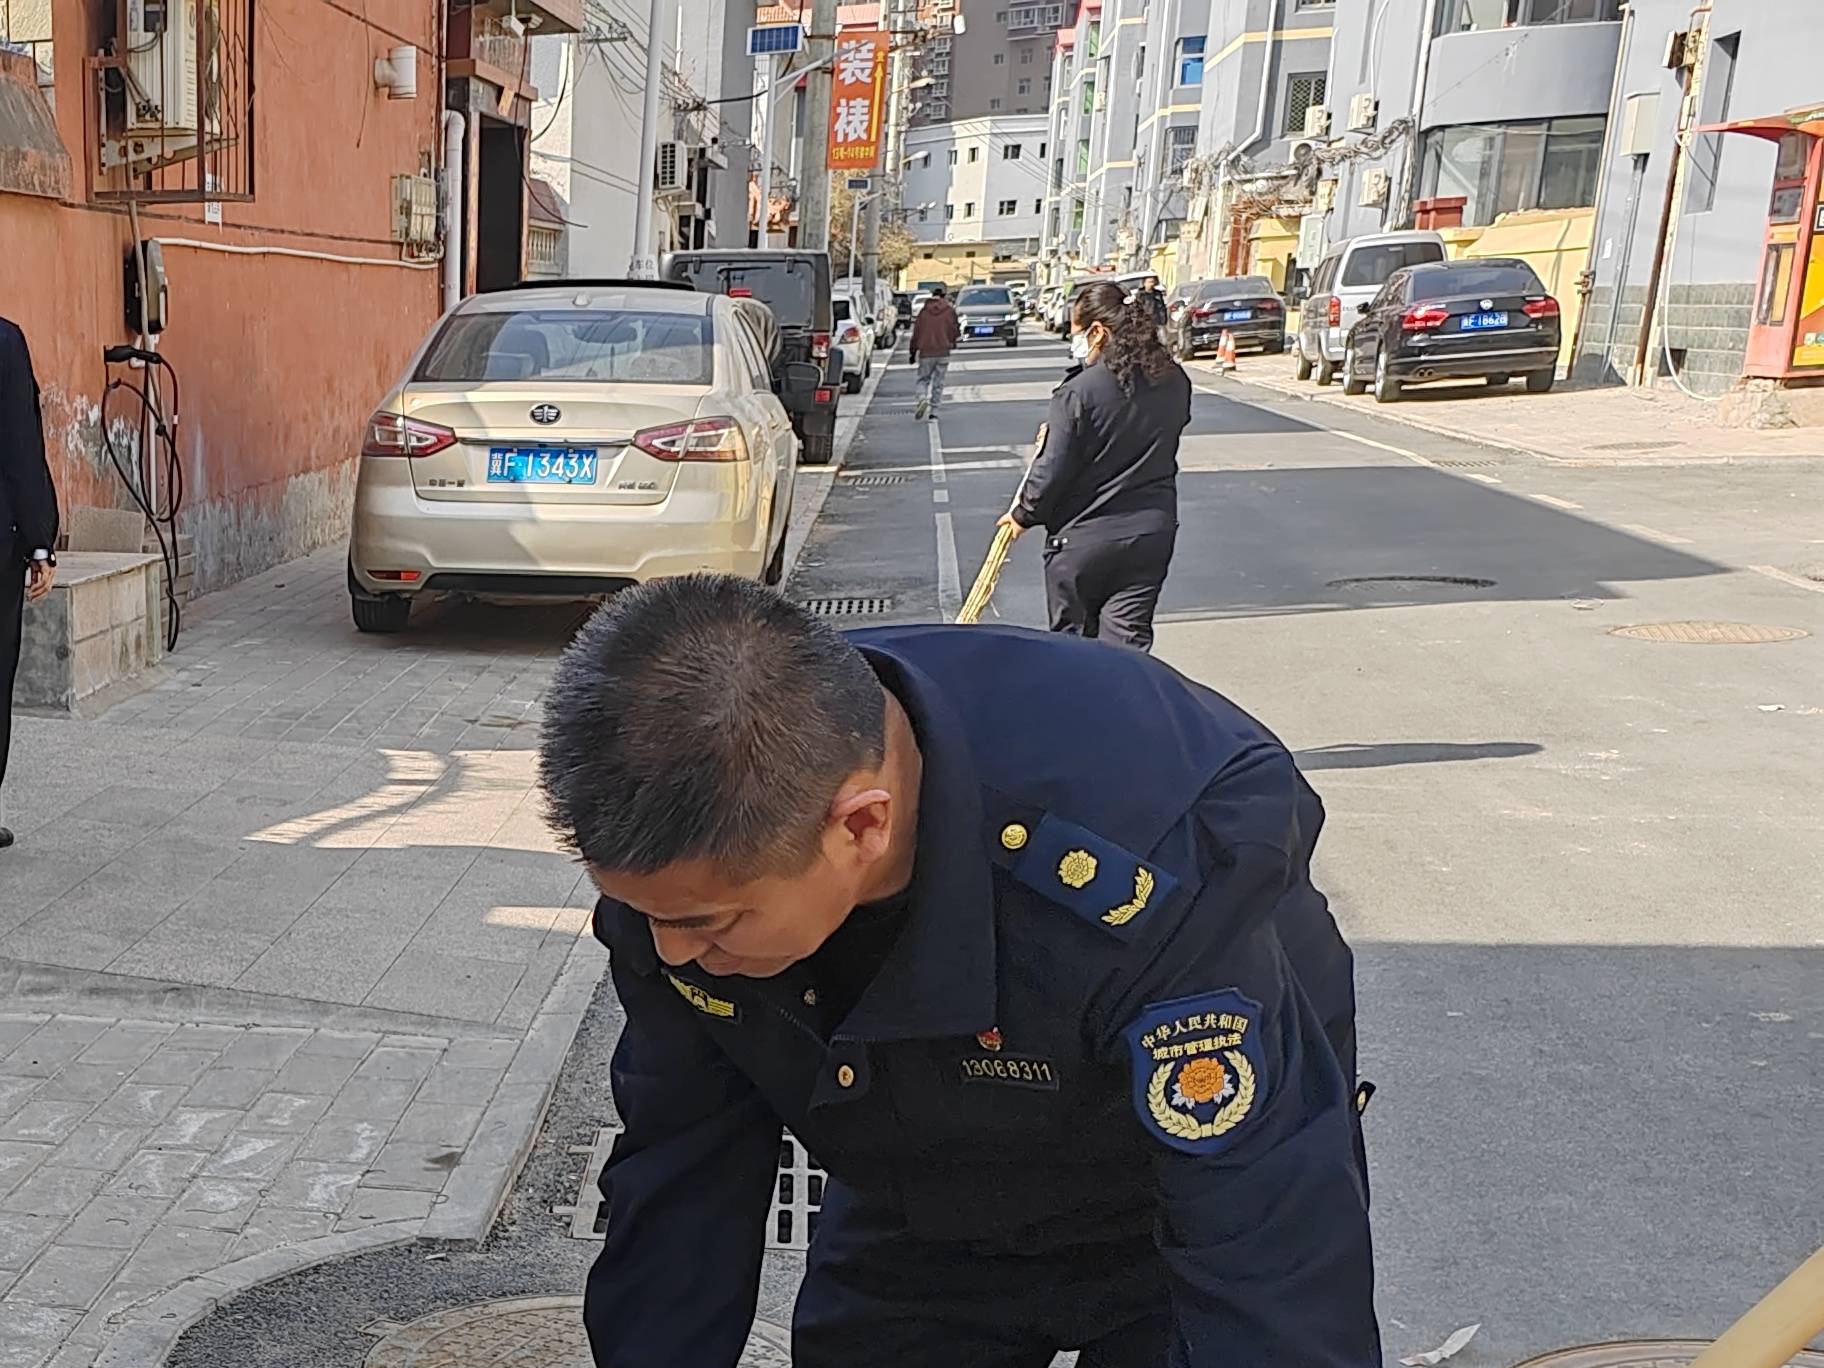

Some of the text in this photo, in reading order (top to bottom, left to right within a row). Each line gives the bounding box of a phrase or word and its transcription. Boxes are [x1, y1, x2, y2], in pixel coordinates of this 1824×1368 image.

[834, 39, 875, 143] 装裱
[1141, 1013, 1249, 1050] 中华人民共和国
[1152, 1032, 1243, 1061] 城市管理执法
[961, 1058, 1052, 1081] 13068311
